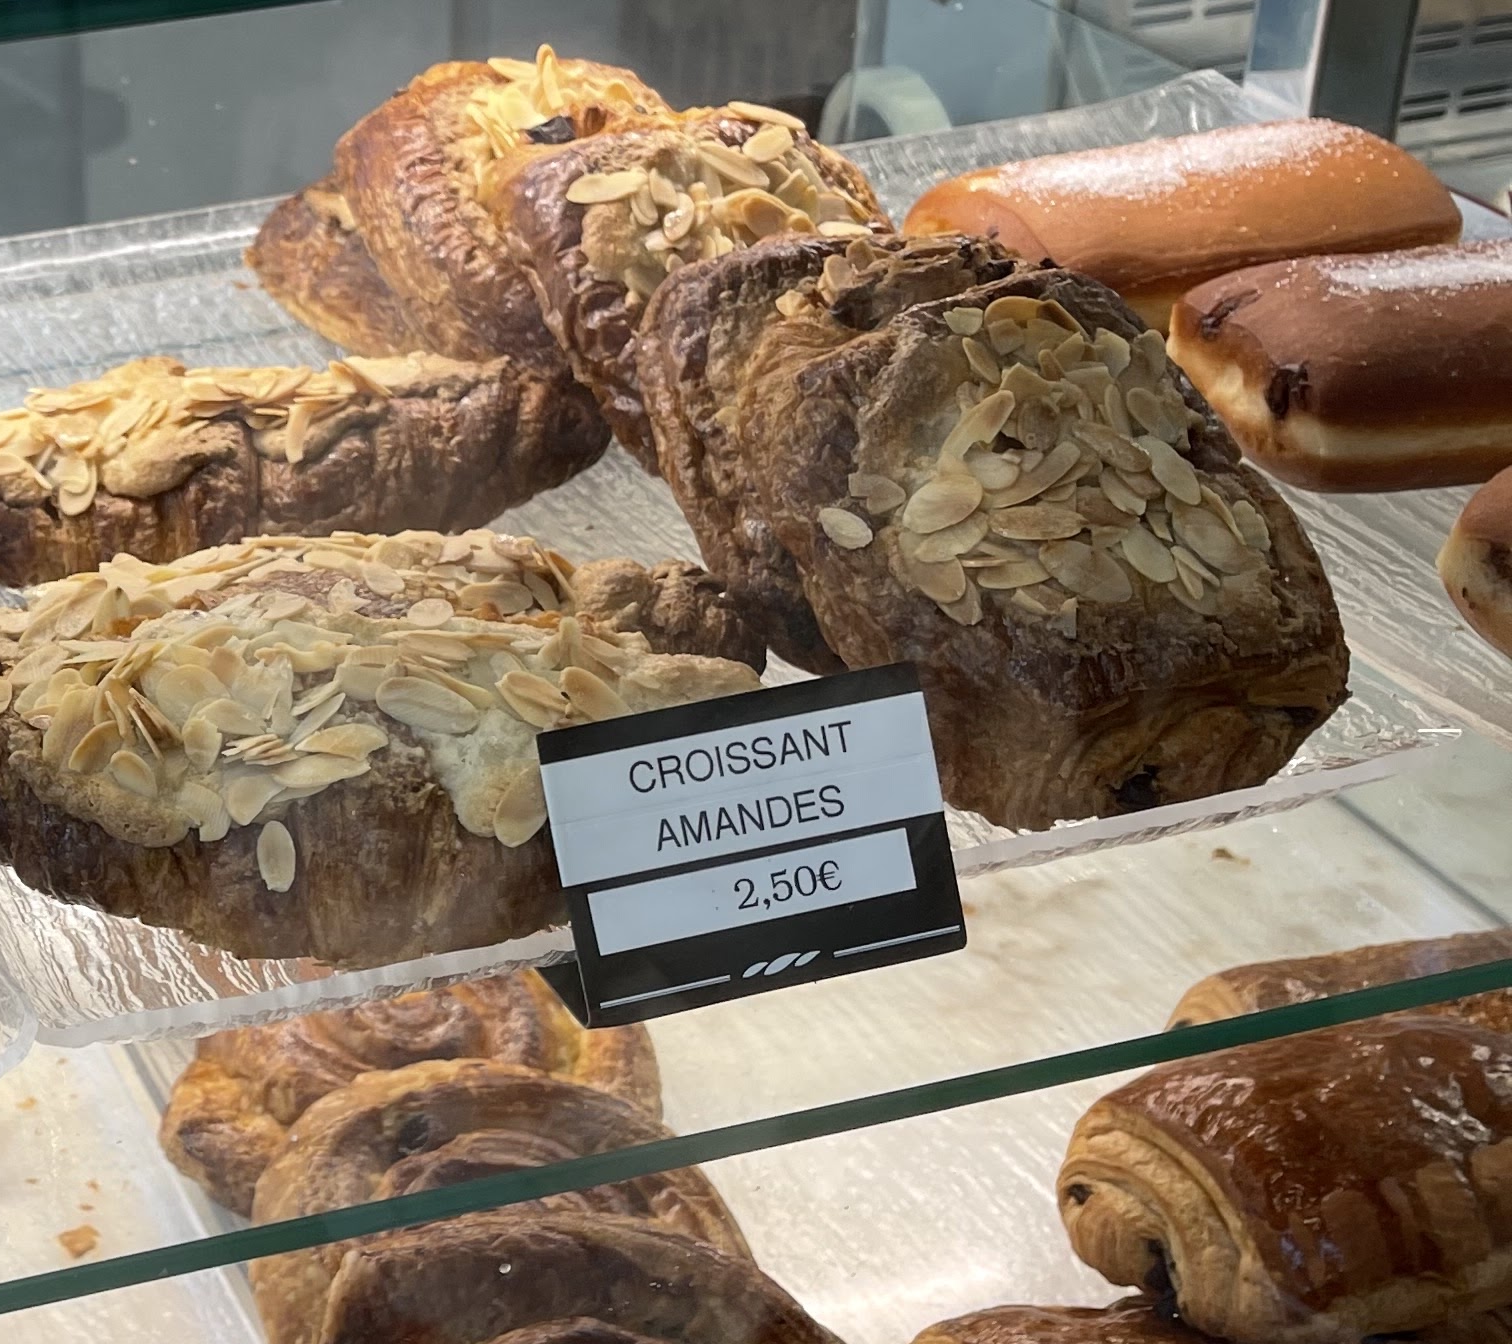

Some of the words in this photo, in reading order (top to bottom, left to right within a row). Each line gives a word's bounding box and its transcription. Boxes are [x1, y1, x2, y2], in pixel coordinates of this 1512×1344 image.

[628, 720, 852, 794] CROISSANT
[656, 784, 845, 852] AMANDES
[733, 860, 843, 910] 2,50€
